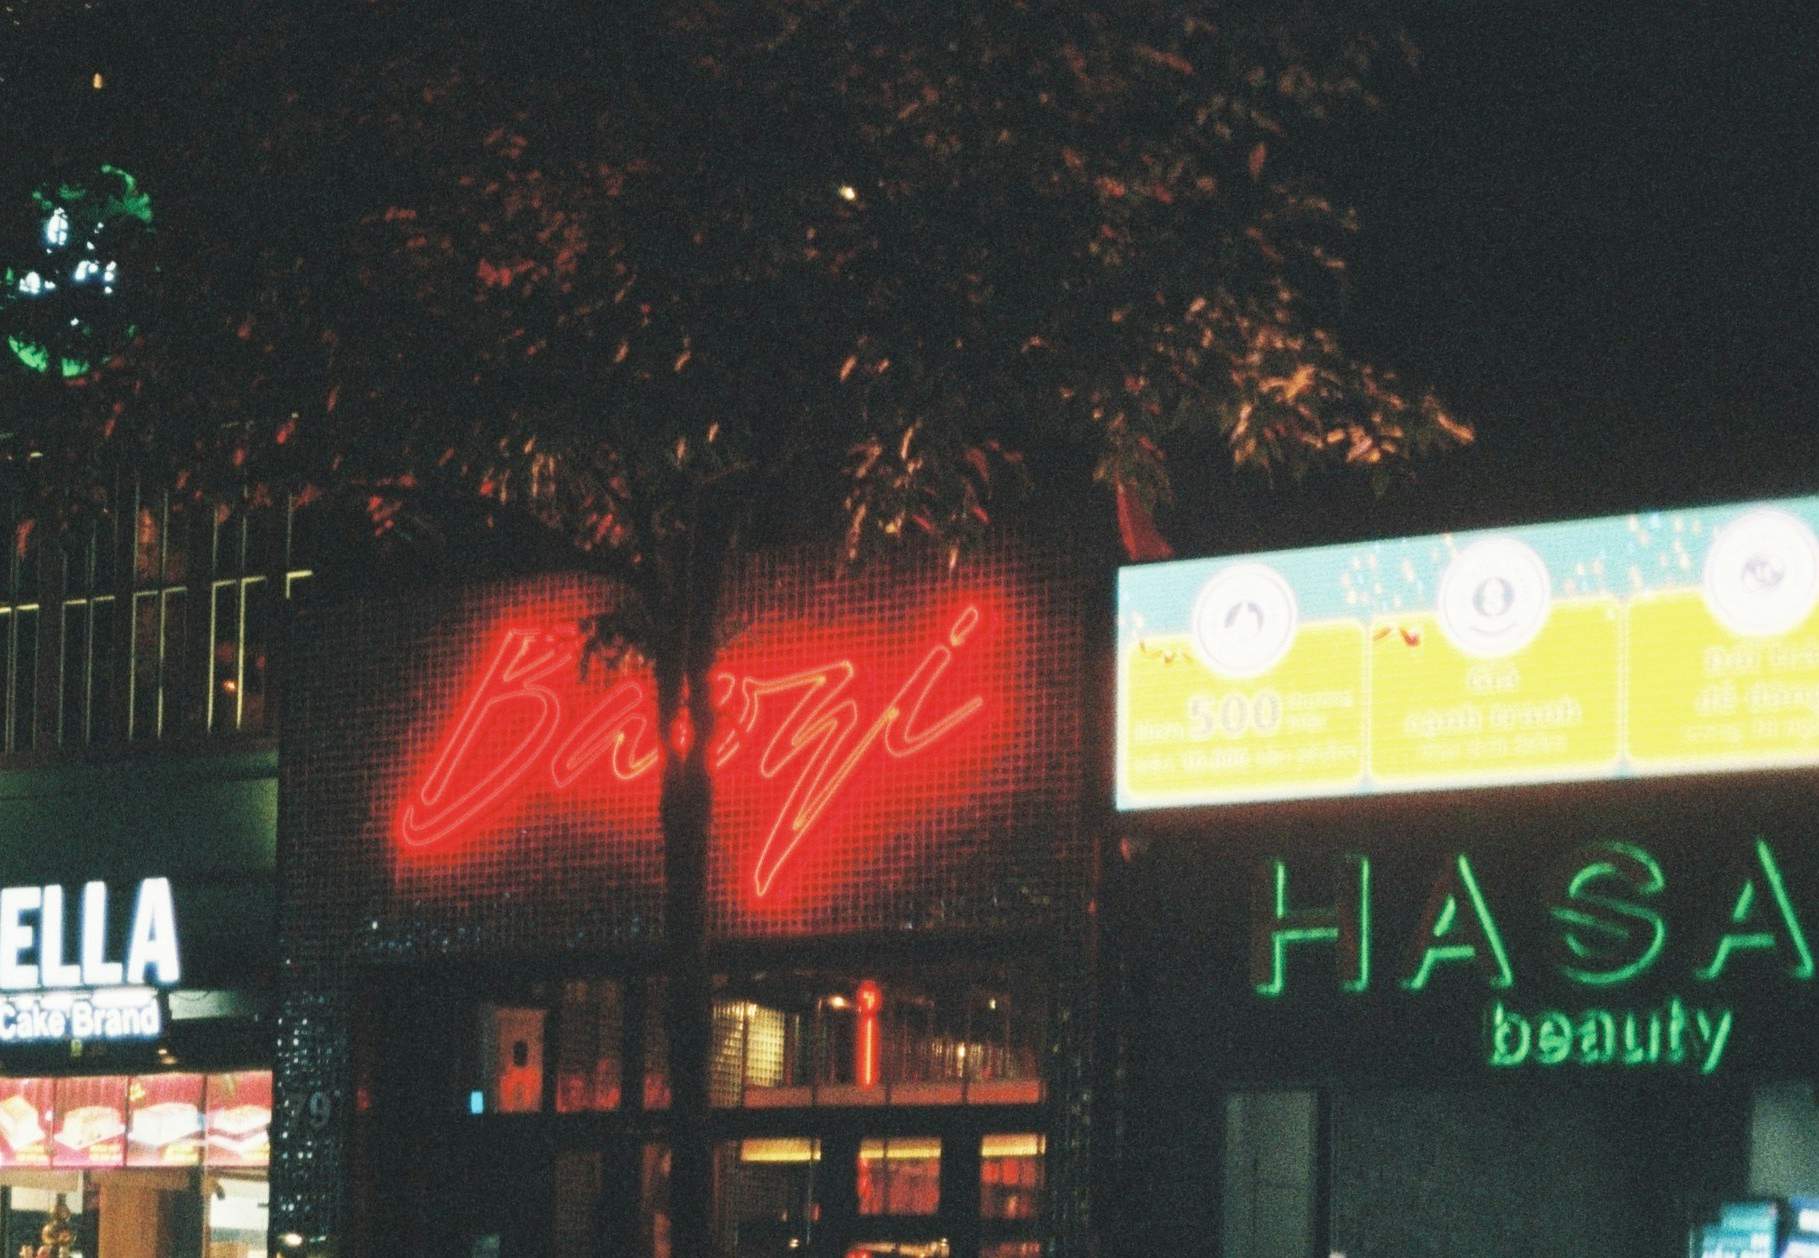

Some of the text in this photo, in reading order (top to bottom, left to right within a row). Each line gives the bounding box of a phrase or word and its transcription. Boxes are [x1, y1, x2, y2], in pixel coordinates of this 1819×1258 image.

[1186, 689, 1282, 738] 500
[71, 1003, 161, 1037] Brand
[1487, 995, 1734, 1074] beauty
